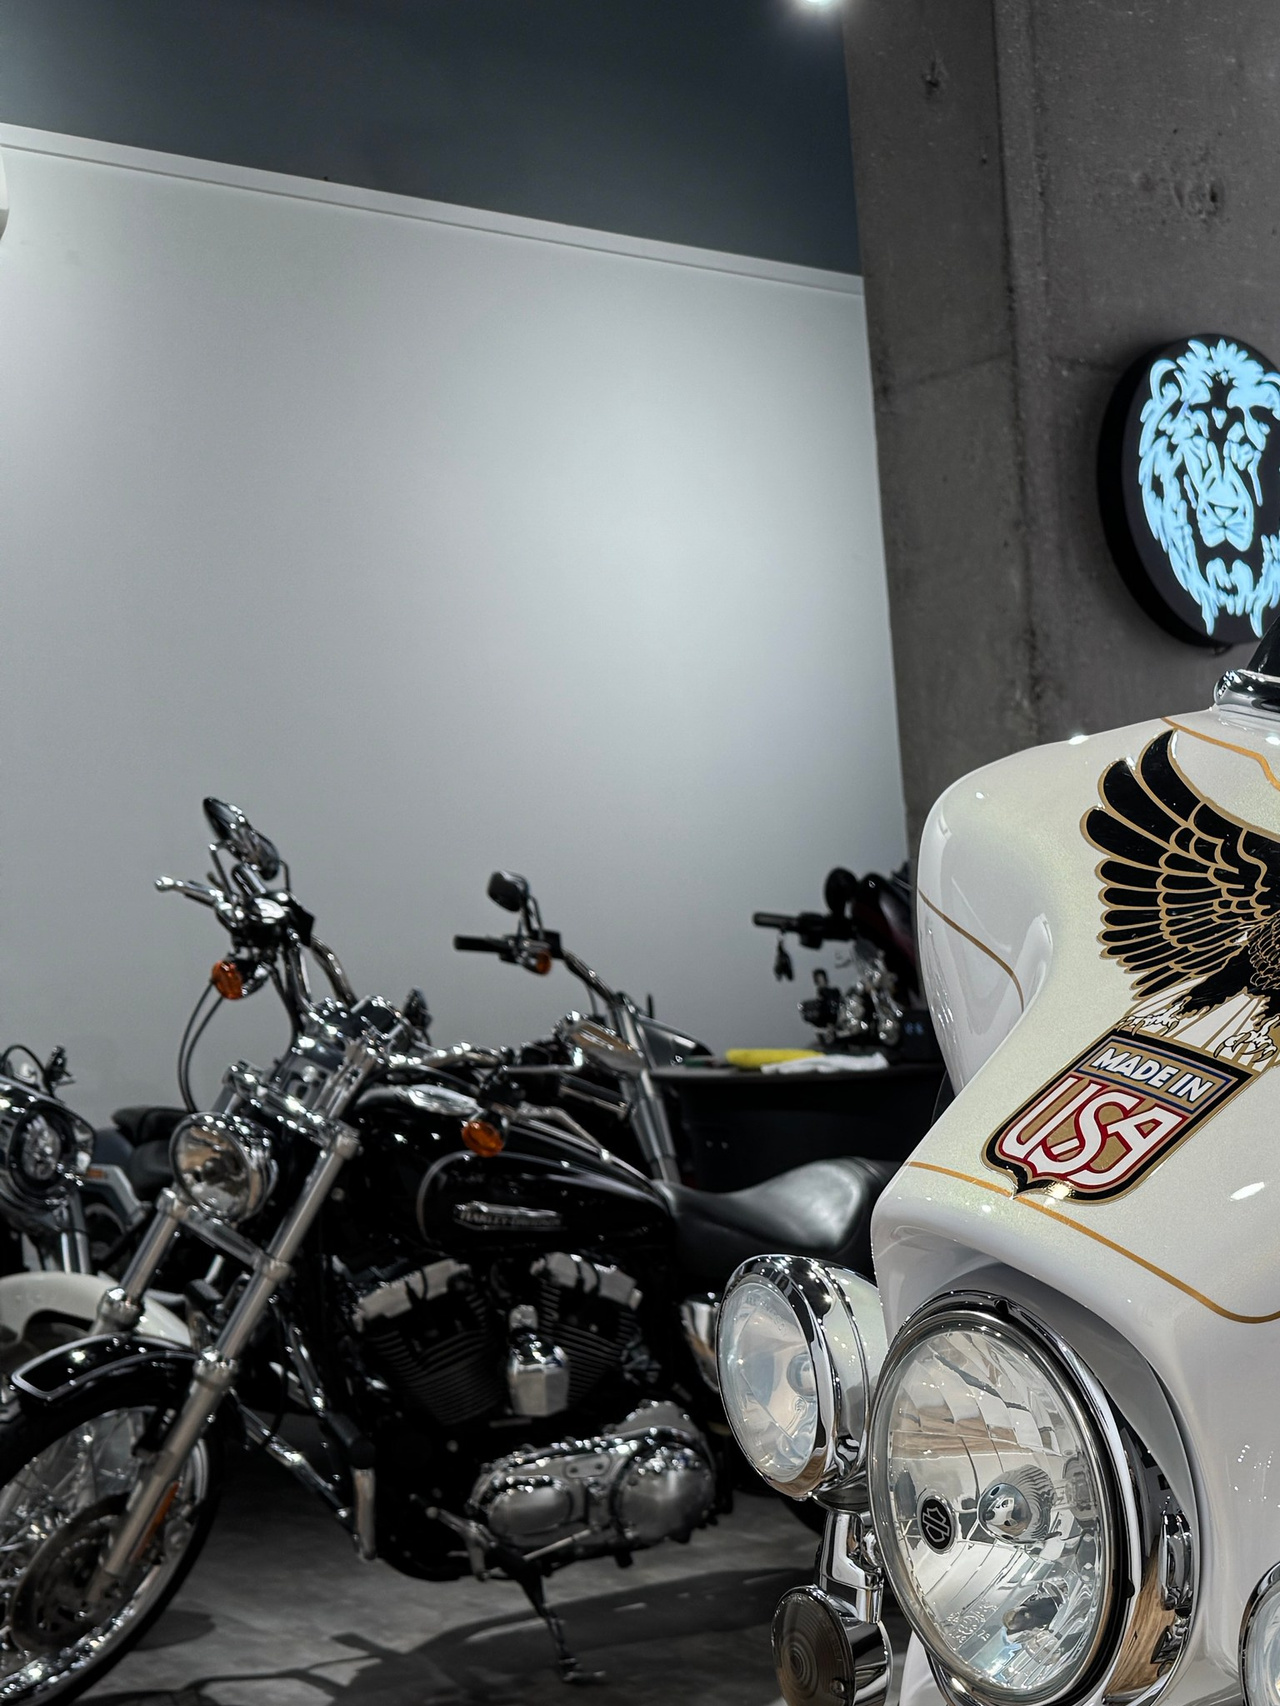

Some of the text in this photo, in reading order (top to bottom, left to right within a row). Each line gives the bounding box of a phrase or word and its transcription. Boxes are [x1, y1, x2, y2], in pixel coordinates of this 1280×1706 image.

[1091, 1048, 1215, 1103] MADE IN
[1000, 1076, 1185, 1188] USA
